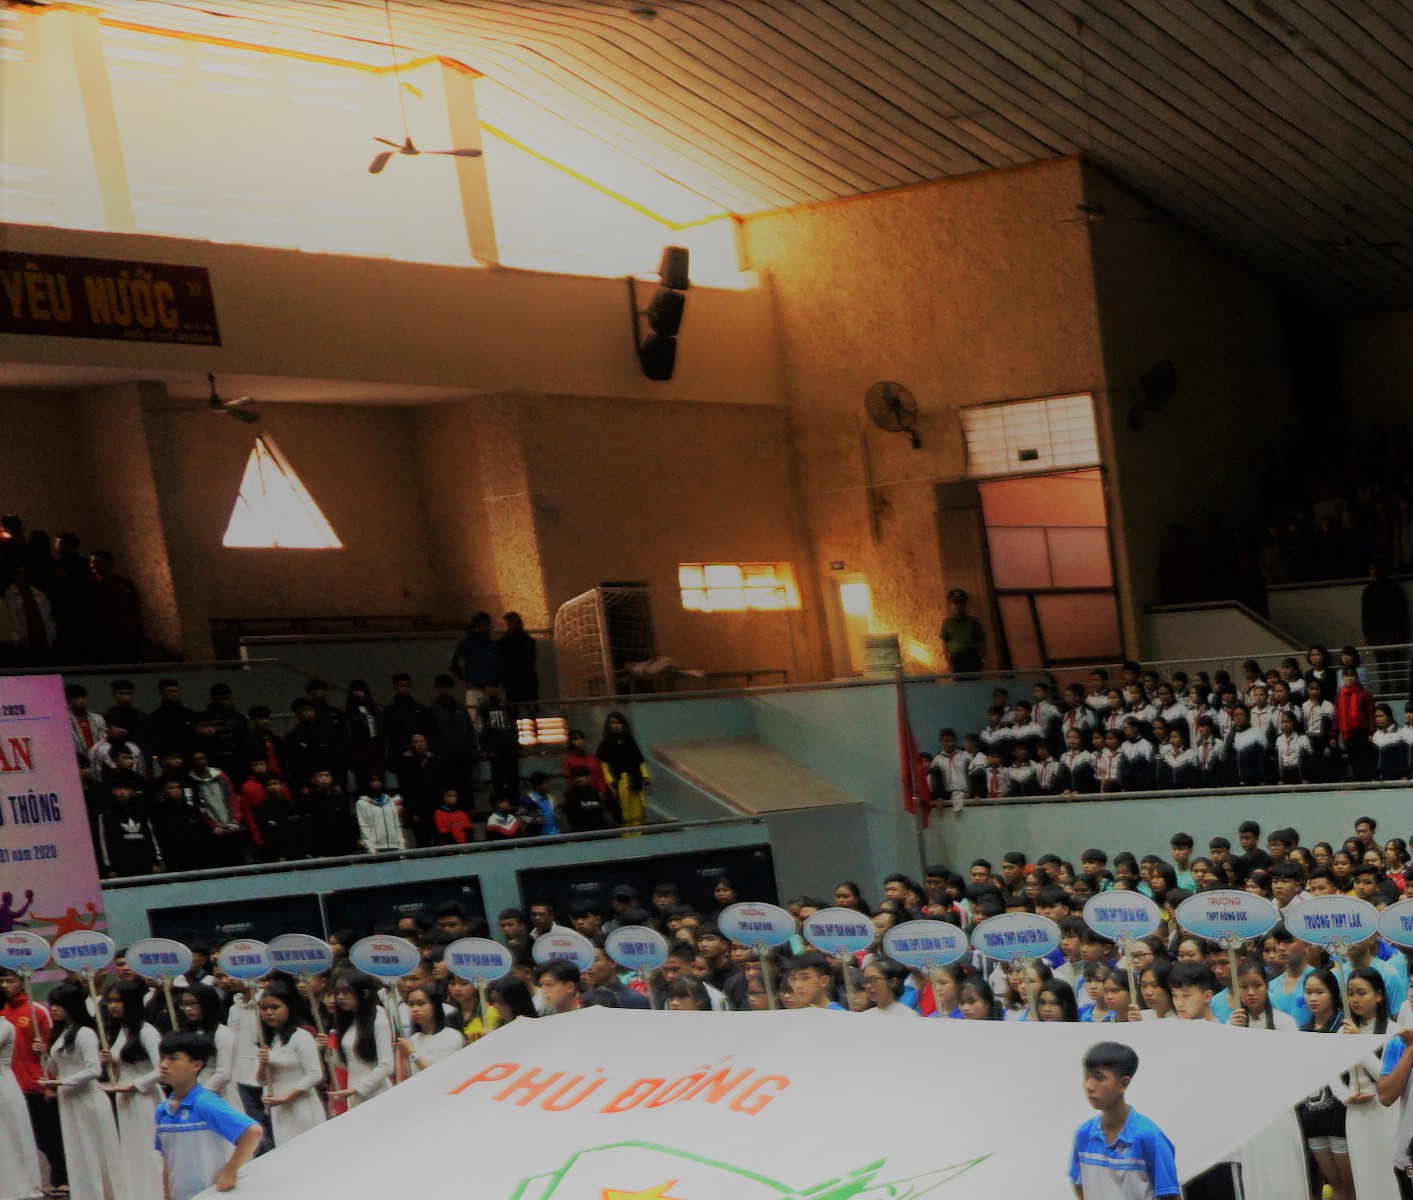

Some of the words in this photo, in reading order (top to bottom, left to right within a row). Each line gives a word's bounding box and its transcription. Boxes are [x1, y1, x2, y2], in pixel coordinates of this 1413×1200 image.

[8, 789, 62, 825] THÔNG
[12, 849, 32, 862] năm
[34, 845, 58, 860] 2020
[446, 1063, 605, 1112] PHÙ
[598, 1055, 790, 1115] ĐỔNG
